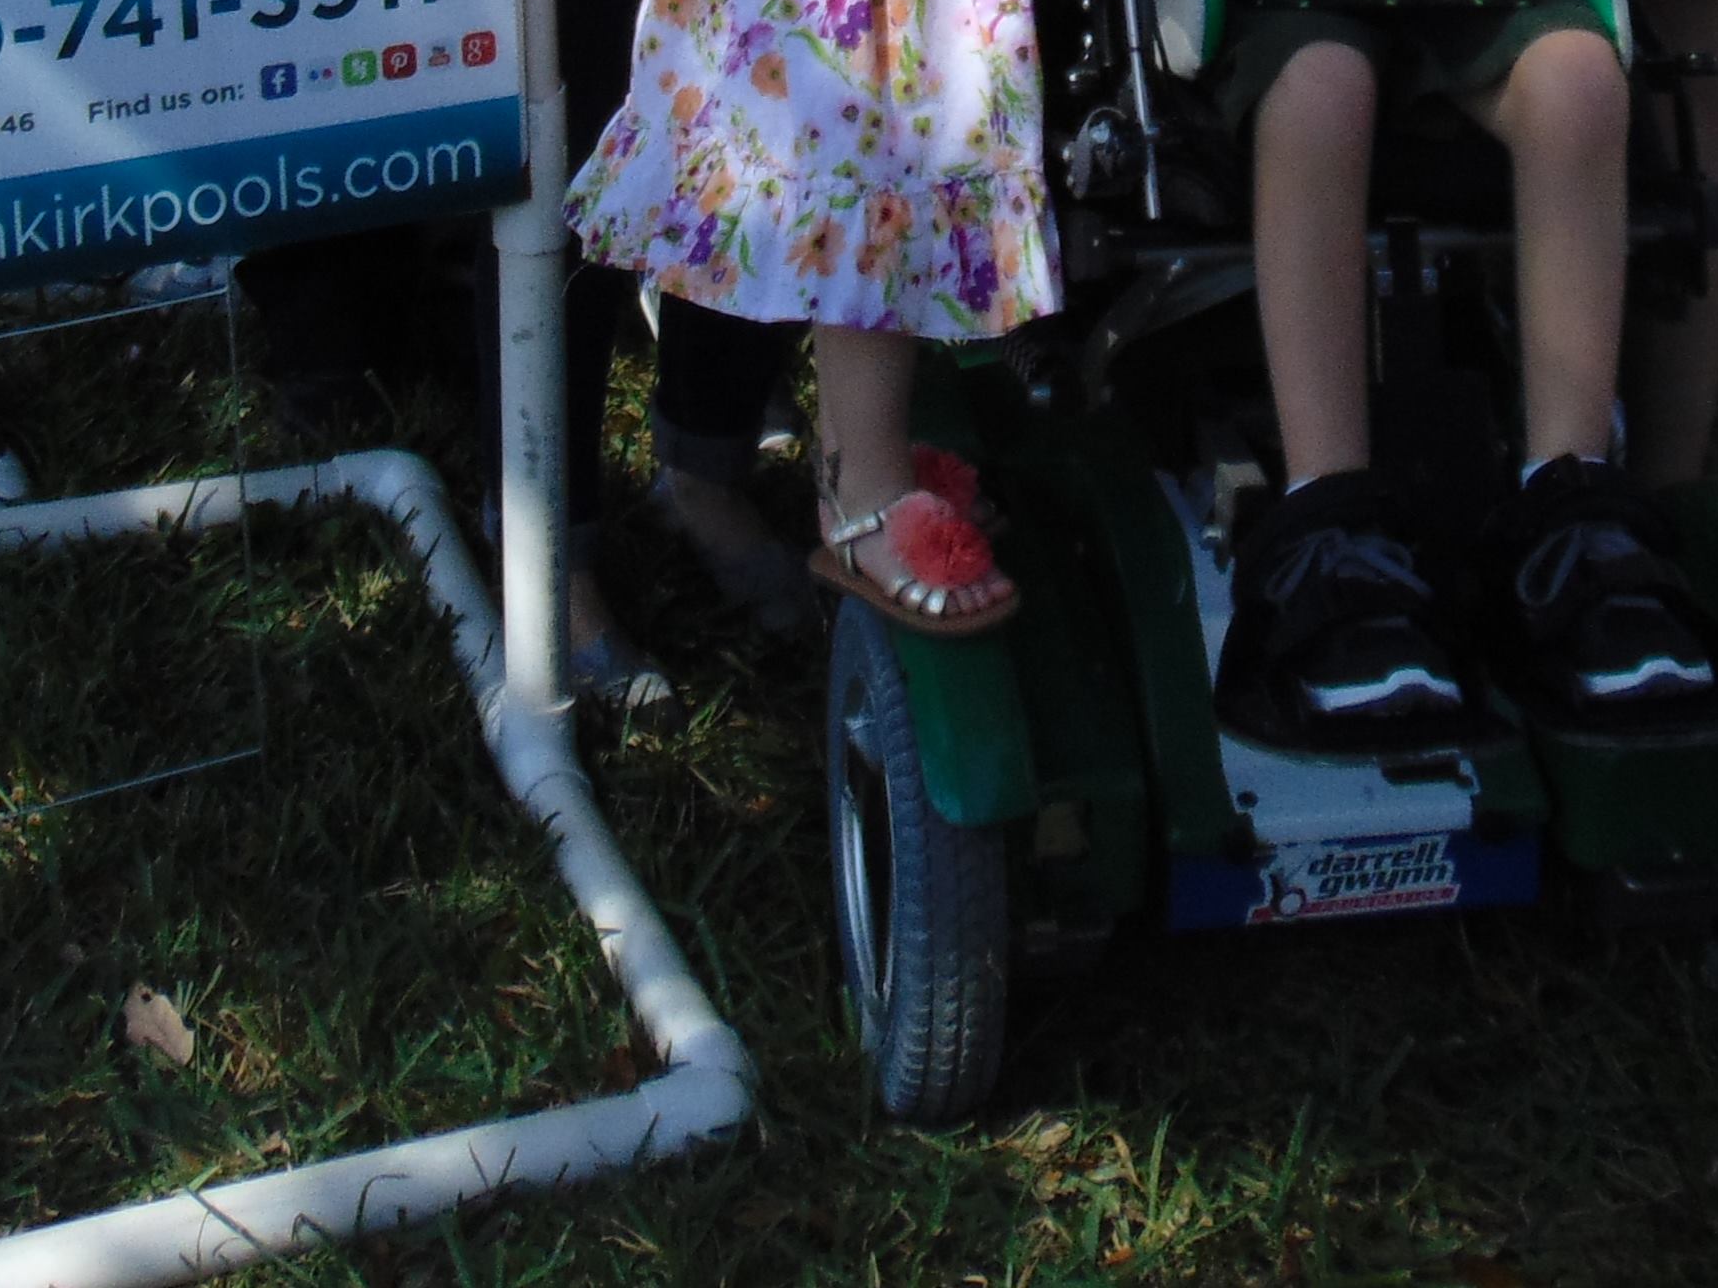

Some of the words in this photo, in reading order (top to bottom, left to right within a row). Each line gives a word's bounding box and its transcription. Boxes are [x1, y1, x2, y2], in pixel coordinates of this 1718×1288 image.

[88, 92, 151, 124] Find
[160, 91, 192, 113] us
[199, 81, 245, 106] on:
[1307, 840, 1439, 876] darrell
[1315, 862, 1447, 900] gwynn
